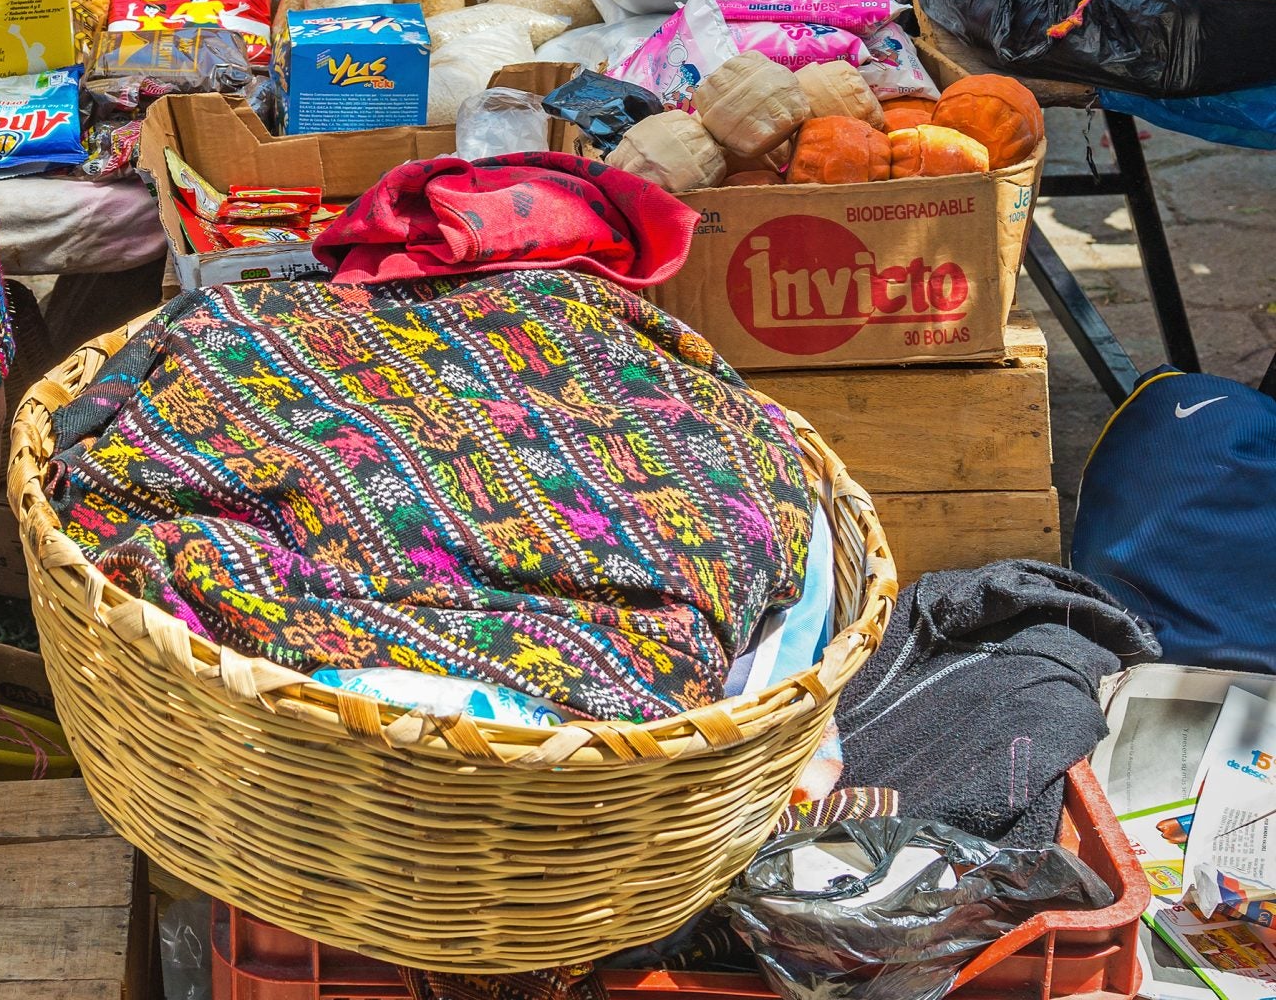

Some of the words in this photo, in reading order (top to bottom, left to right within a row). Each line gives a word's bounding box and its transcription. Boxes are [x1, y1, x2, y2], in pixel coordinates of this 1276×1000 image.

[748, 3, 792, 13] blanca
[793, 1, 837, 13] nieves
[860, 0, 878, 9] 100
[0, 55, 5, 63] al
[328, 53, 387, 86] Yus
[372, 79, 395, 89] Toki
[846, 197, 976, 224] BIODEGRADABLE
[241, 268, 270, 280] SOPA
[904, 330, 921, 346] 30
[923, 327, 971, 345] BOLAS
[1226, 758, 1241, 770] de
